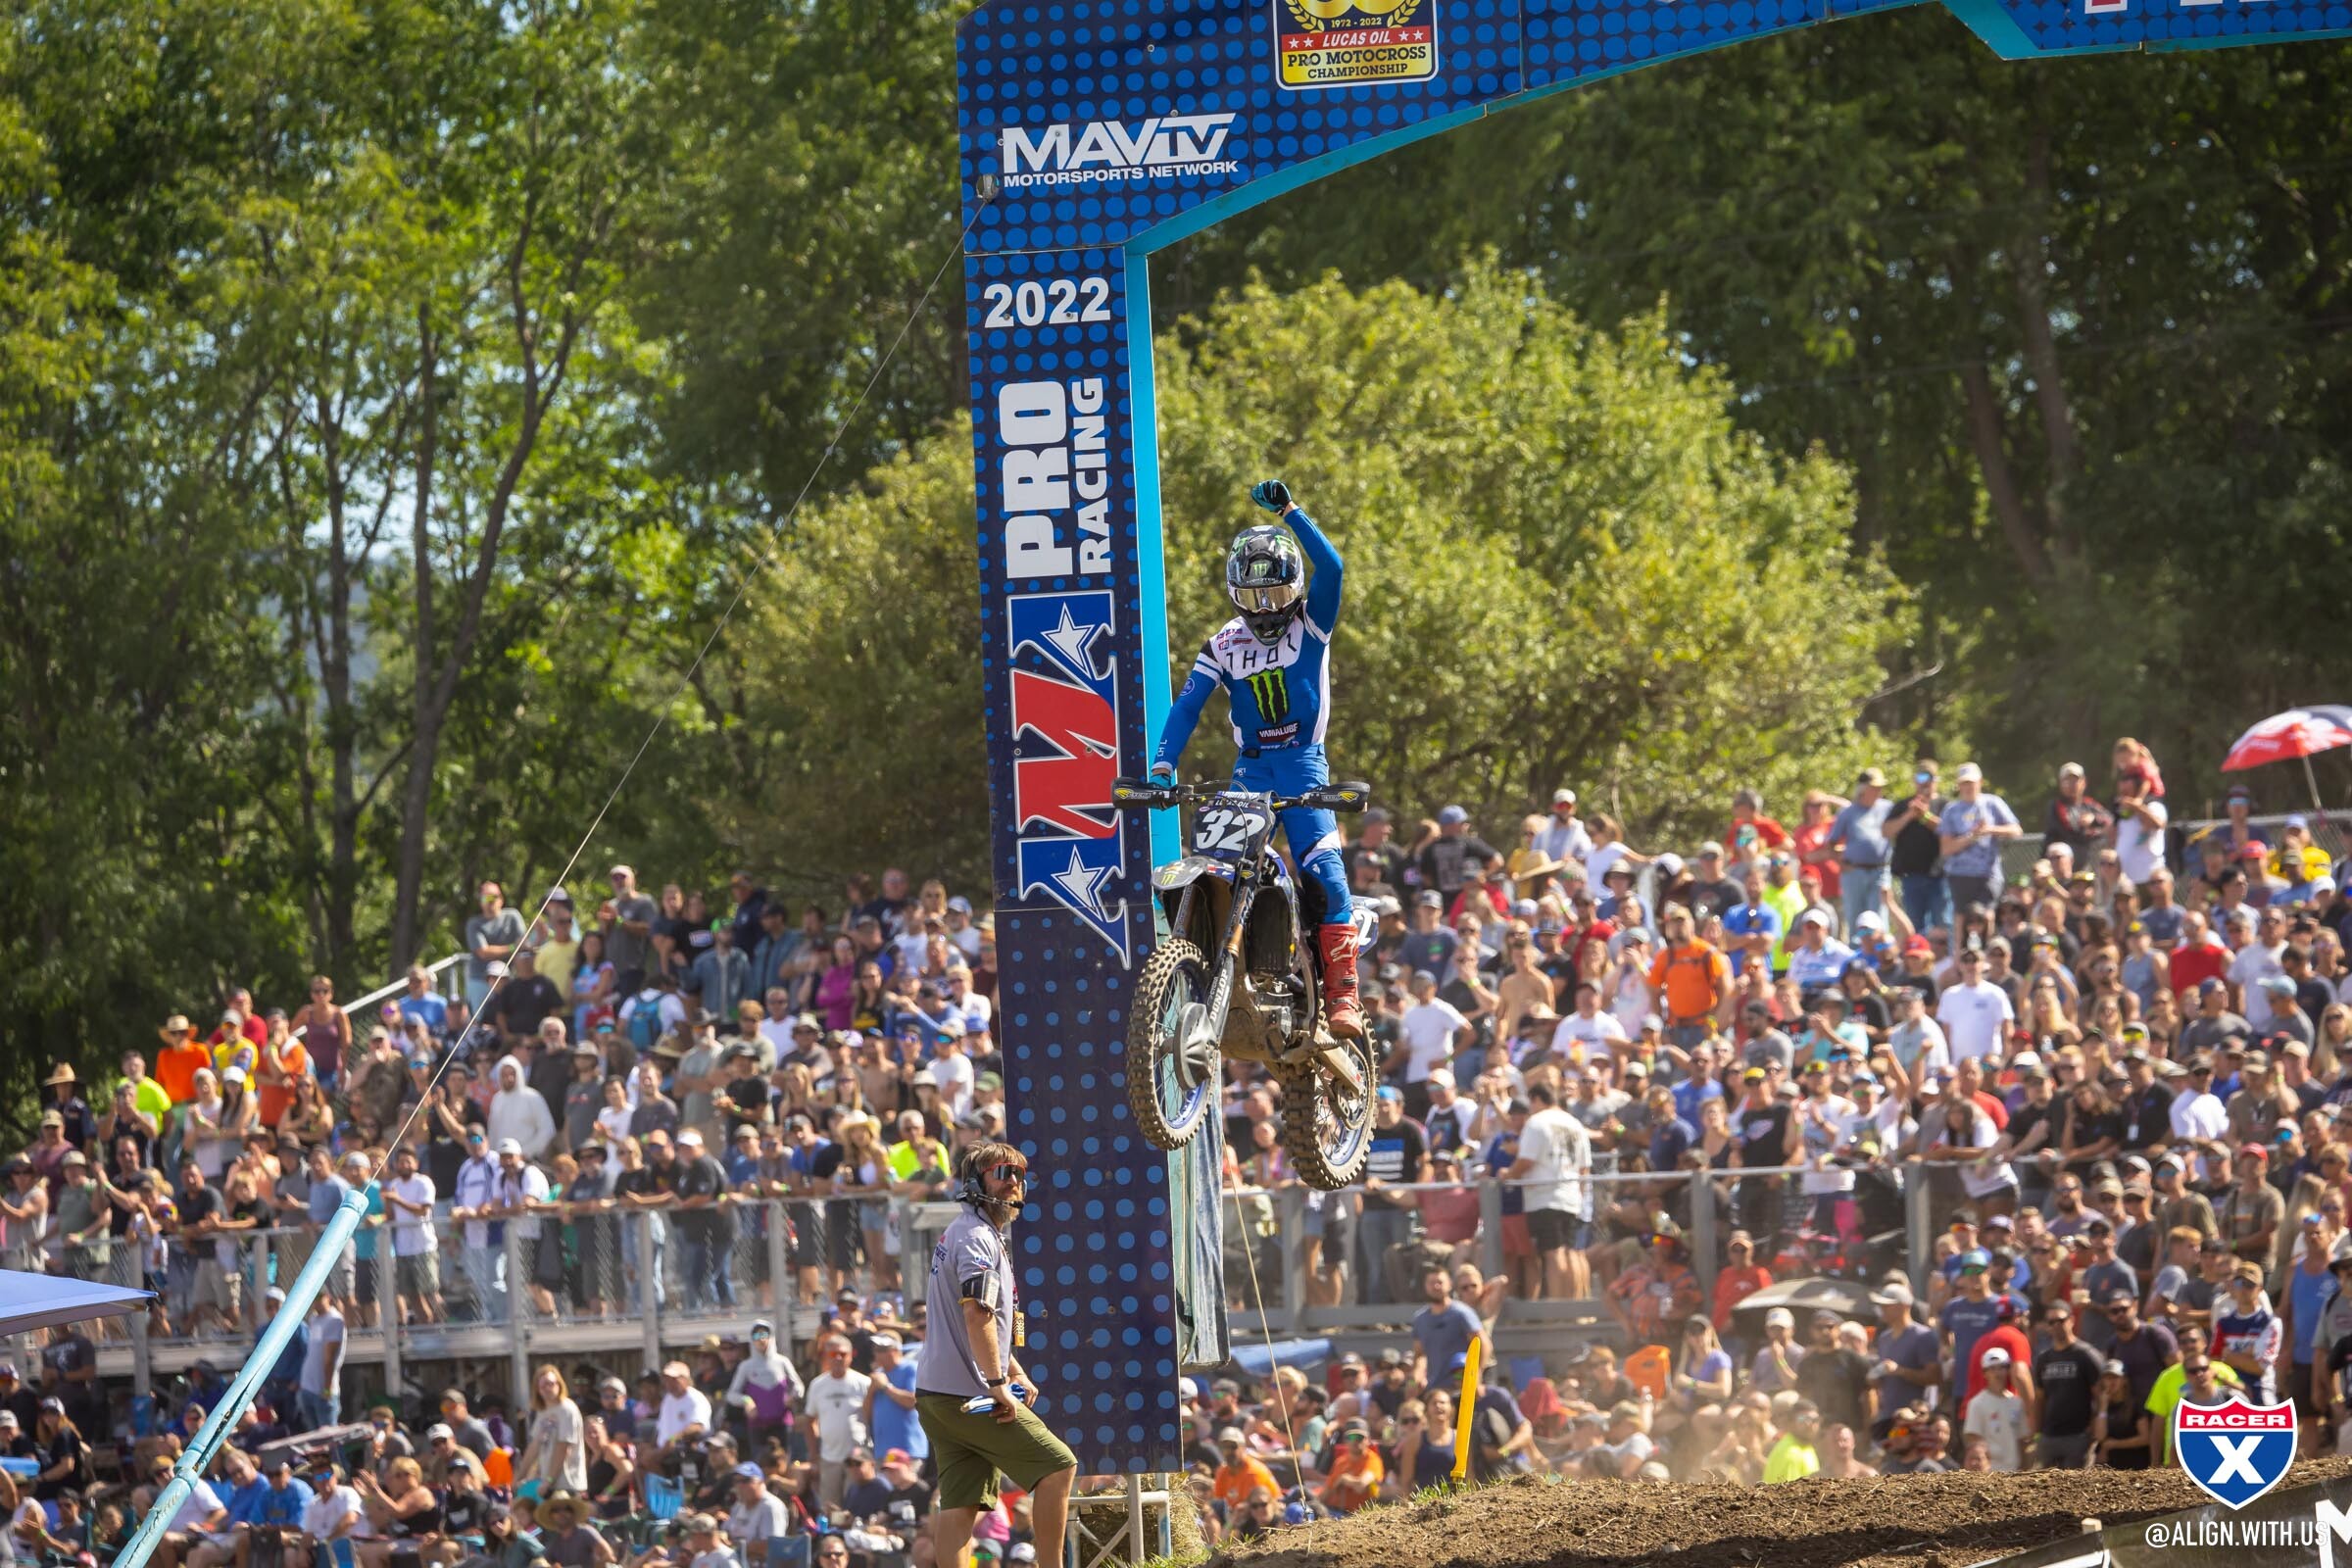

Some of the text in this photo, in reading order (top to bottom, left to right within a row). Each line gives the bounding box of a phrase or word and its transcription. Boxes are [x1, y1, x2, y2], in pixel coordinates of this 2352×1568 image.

[1322, 30, 1392, 48] LUCAS OIL
[1331, 20, 1351, 28] 1972
[1359, 17, 1383, 26] 2022
[1287, 46, 1427, 67] PRO MOTOCROSS
[1307, 63, 1408, 79] CHAMPIONSHIP
[1004, 161, 1239, 188] MOTORSPORTS NETWORK
[983, 276, 1111, 329] 2022
[998, 380, 1074, 580] PRO
[1071, 377, 1112, 575] RACING
[1196, 808, 1266, 853] 32
[1209, 968, 1228, 1022] DUNLOP
